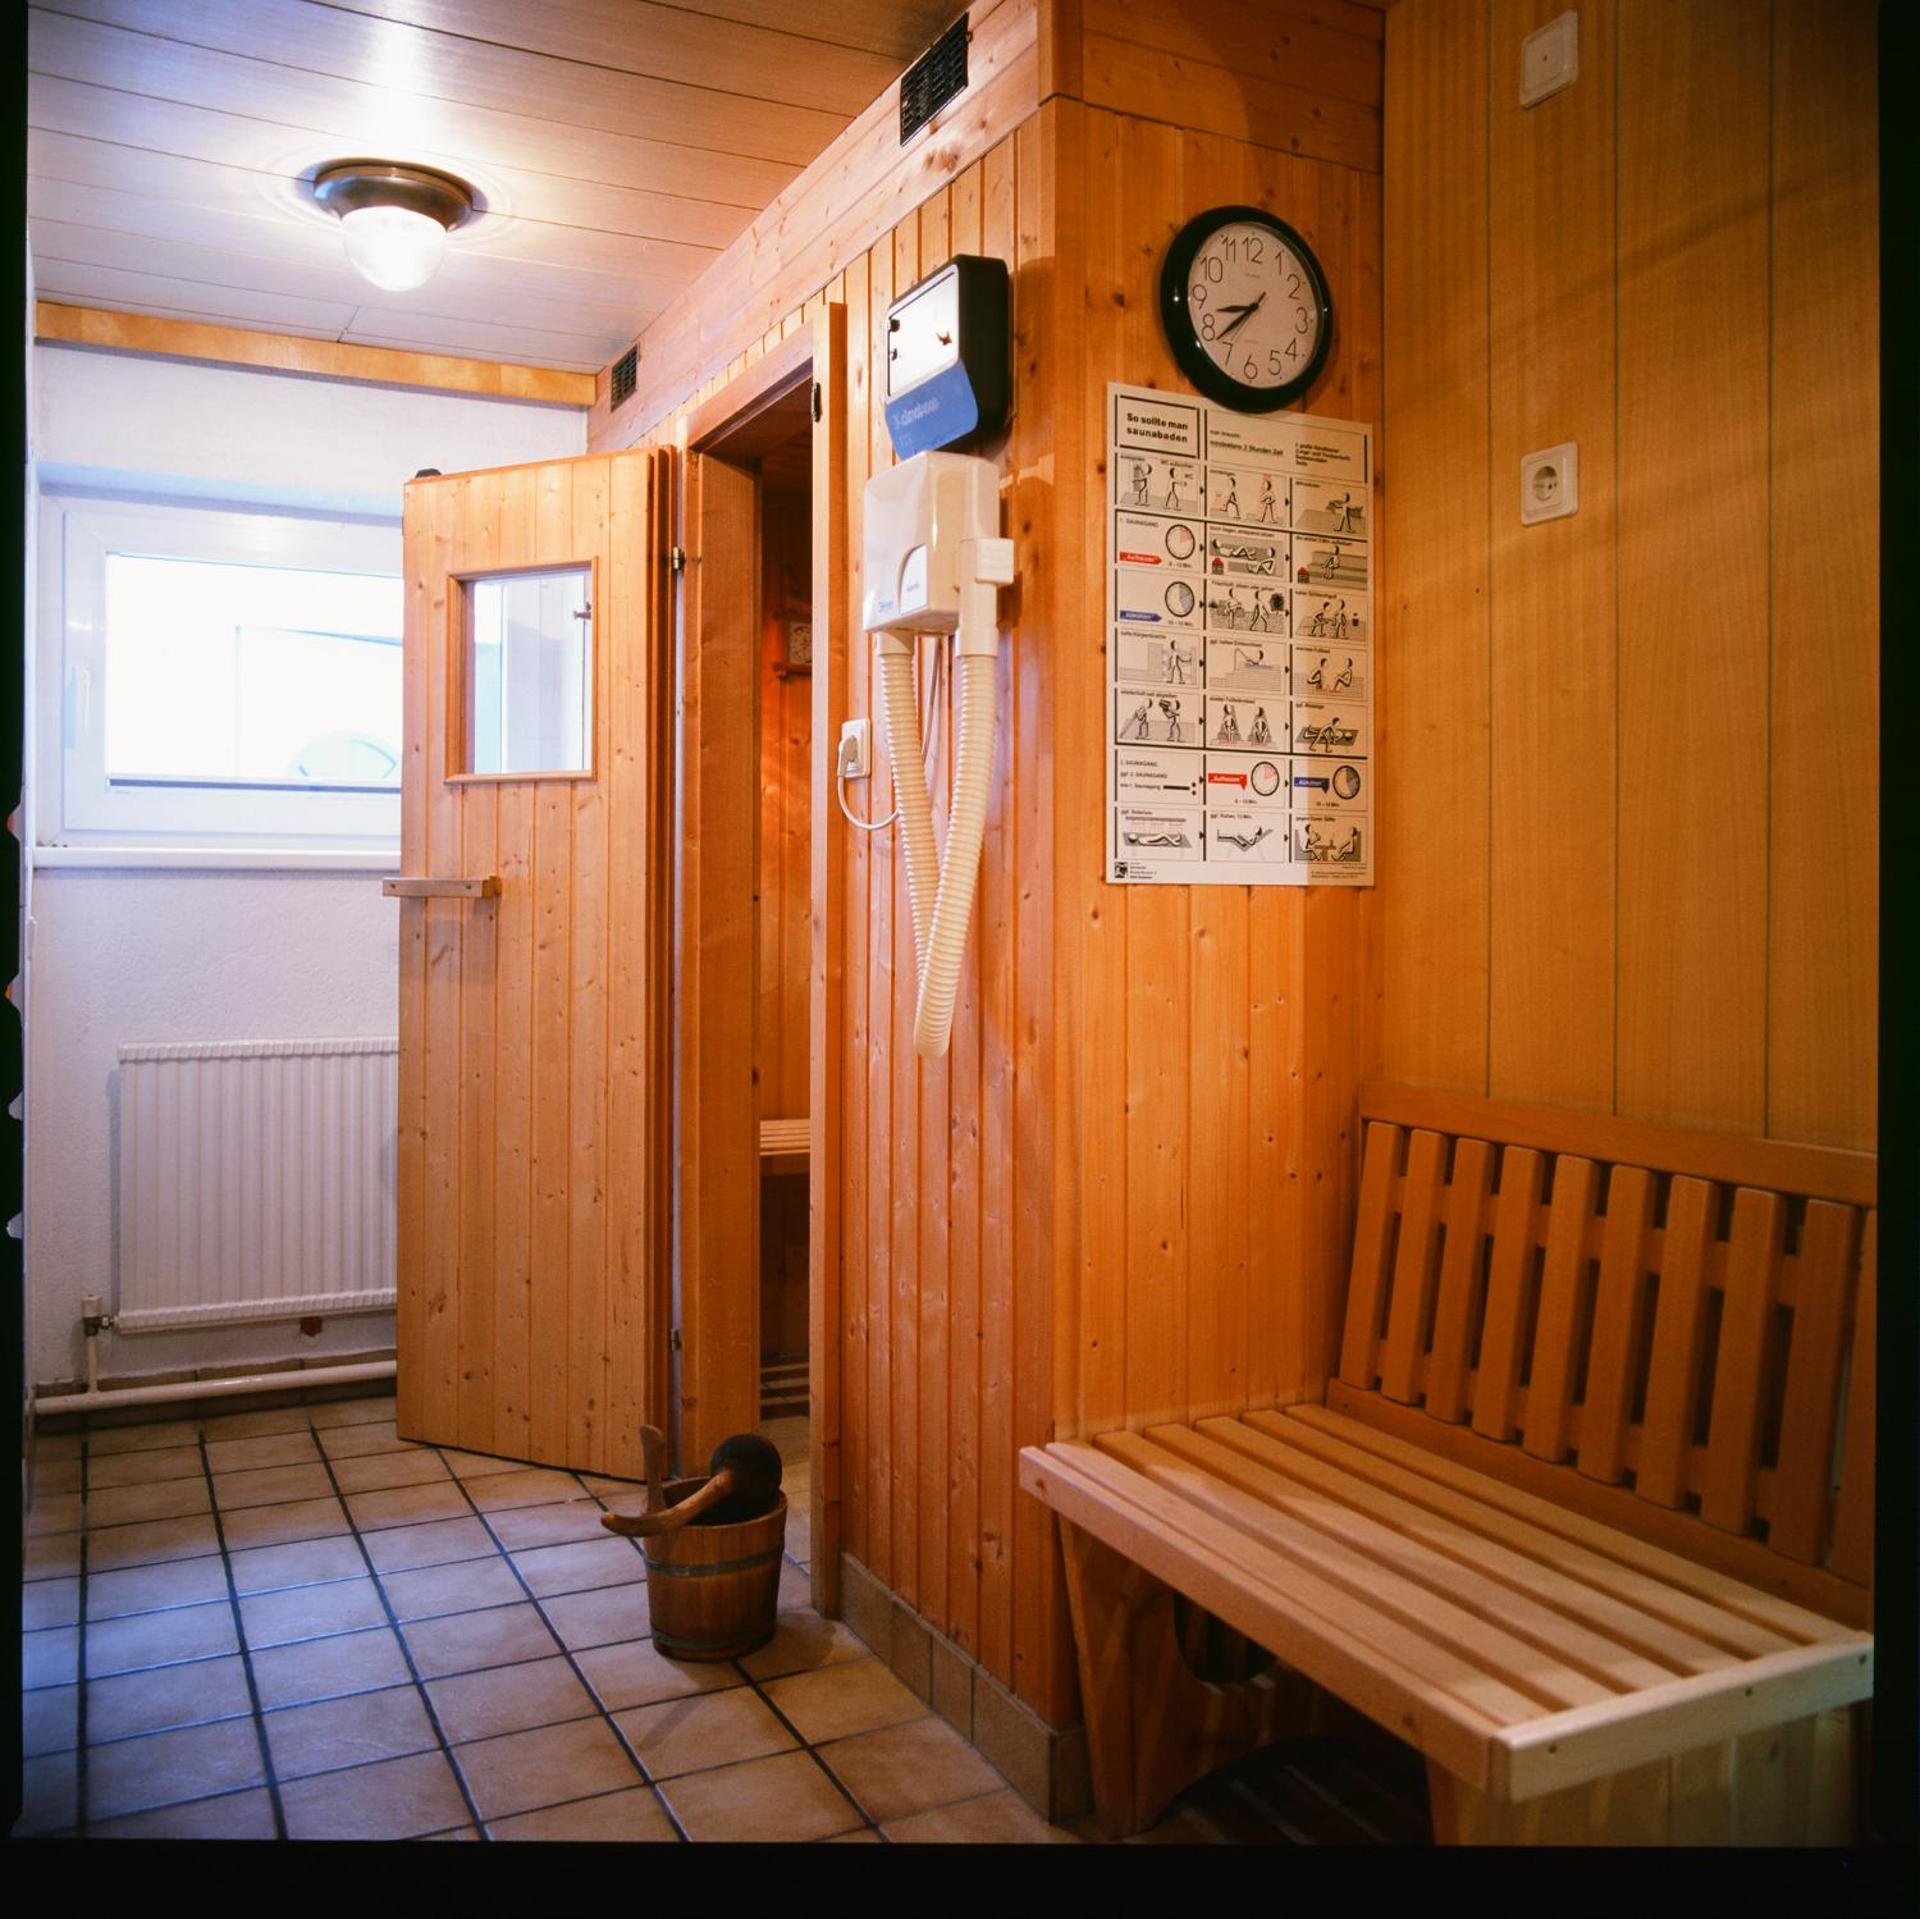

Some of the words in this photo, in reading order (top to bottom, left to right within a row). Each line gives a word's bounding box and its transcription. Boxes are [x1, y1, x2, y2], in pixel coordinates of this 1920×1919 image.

[1221, 236, 1237, 264] 11
[1242, 236, 1264, 264] 12
[1274, 251, 1284, 275] 1
[1200, 256, 1223, 283] 10
[1192, 284, 1207, 310] 9
[1287, 273, 1300, 300] 2
[1202, 313, 1215, 342] 8
[1295, 306, 1308, 334] 3
[1222, 341, 1233, 365] 7
[1267, 350, 1281, 375] 5
[1285, 337, 1298, 362] 4
[1243, 354, 1258, 380] 6
[1126, 412, 1139, 423] So
[1141, 416, 1167, 427] sollte
[1168, 420, 1189, 431] man
[1126, 427, 1189, 444] saunabaden
